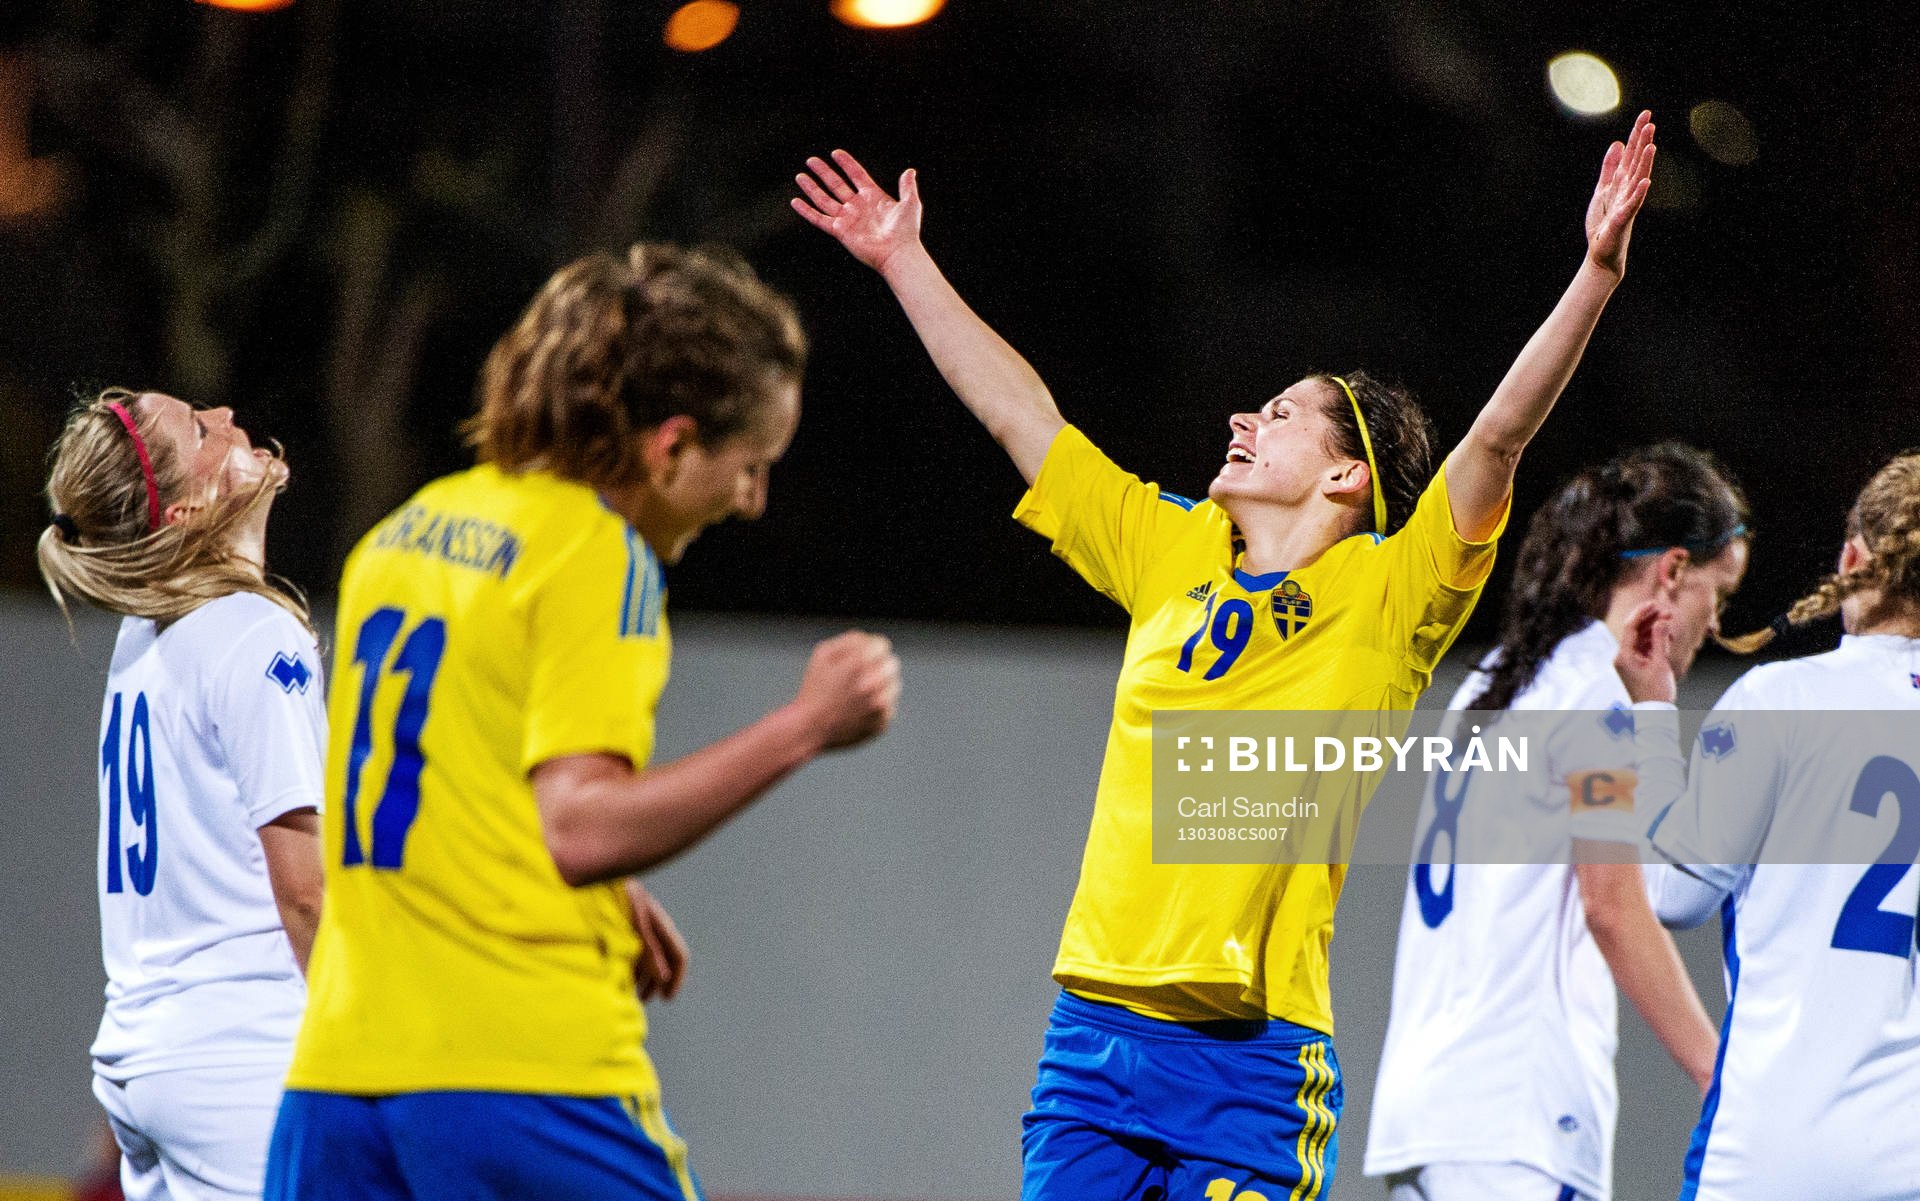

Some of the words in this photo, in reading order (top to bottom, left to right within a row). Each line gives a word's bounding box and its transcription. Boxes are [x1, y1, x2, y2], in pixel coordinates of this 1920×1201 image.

[1176, 591, 1254, 681] 19
[102, 691, 158, 896] 19
[343, 605, 446, 871] 11
[1415, 738, 1477, 929] 8
[1582, 772, 1616, 807] C
